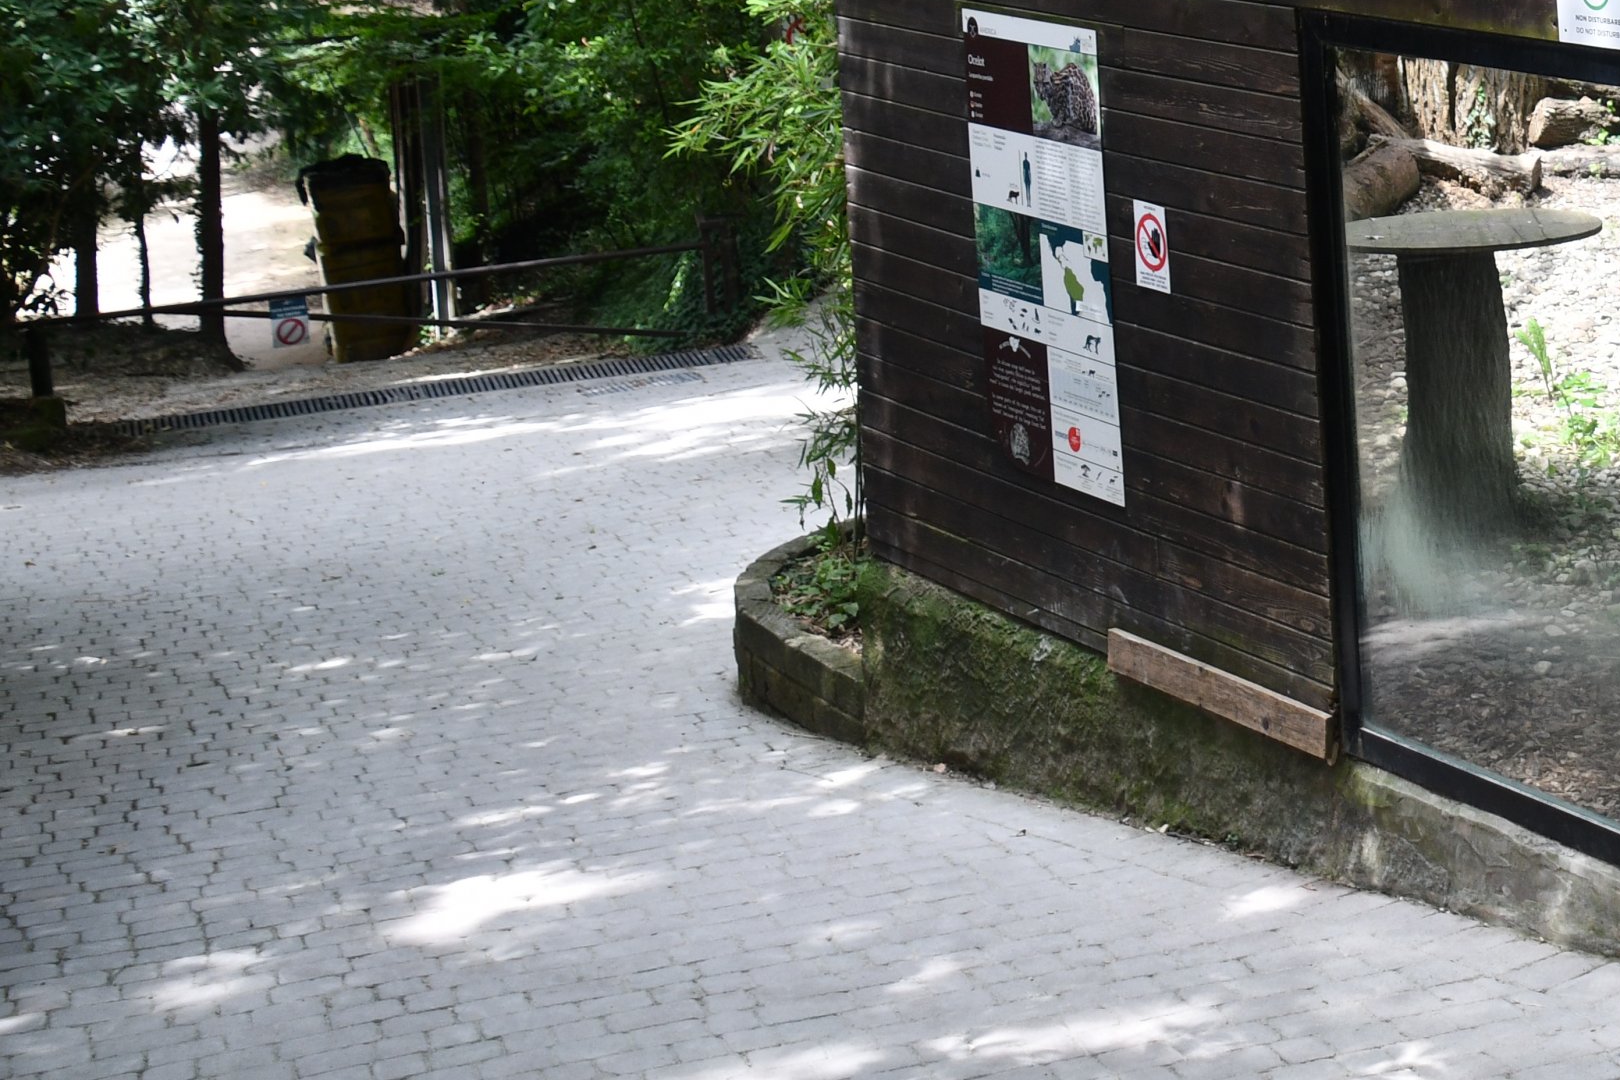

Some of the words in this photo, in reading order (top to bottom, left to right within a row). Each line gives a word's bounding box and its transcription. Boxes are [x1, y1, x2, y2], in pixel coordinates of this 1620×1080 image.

[1588, 16, 1620, 26] DISTURBARE
[1585, 28, 1596, 36] NOT
[1597, 29, 1620, 39] DISTURB
